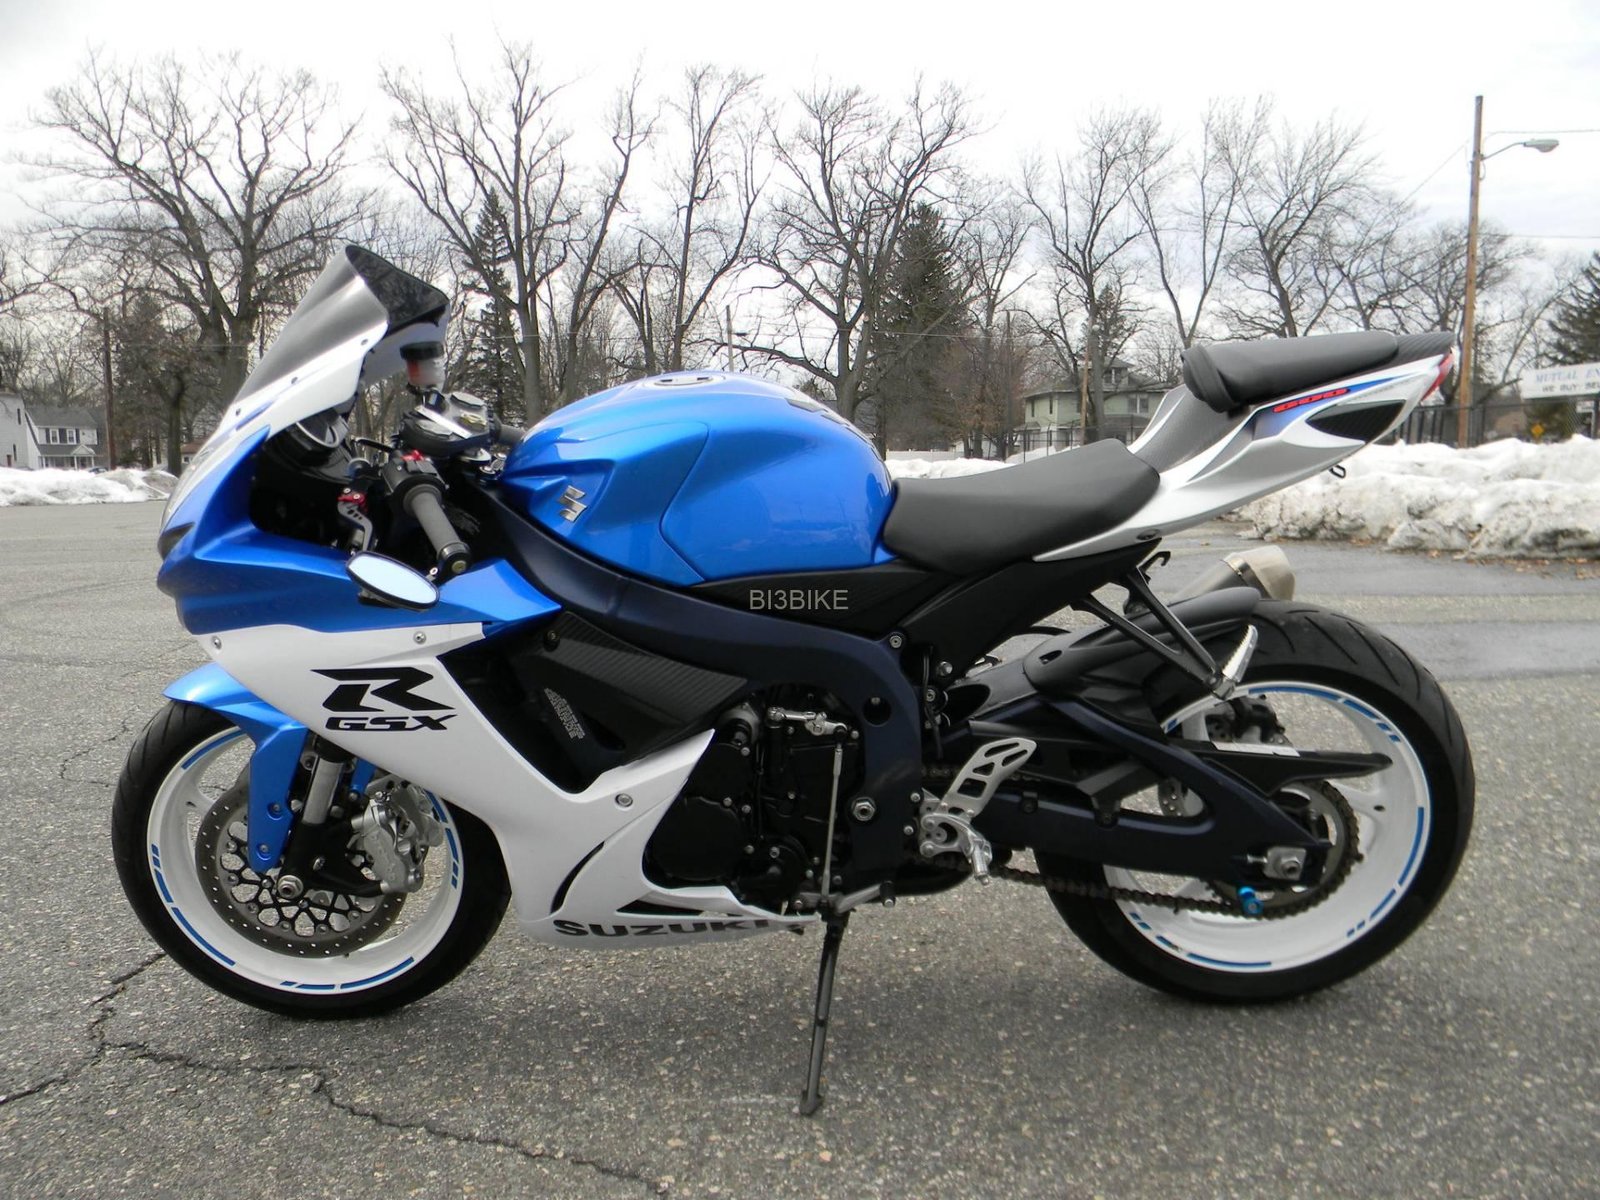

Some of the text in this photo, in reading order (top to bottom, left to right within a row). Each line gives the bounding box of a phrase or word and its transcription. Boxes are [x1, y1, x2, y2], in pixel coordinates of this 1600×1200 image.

[310, 667, 456, 712] R
[325, 714, 457, 731] GSX
[553, 909, 770, 937] SUZUKI
